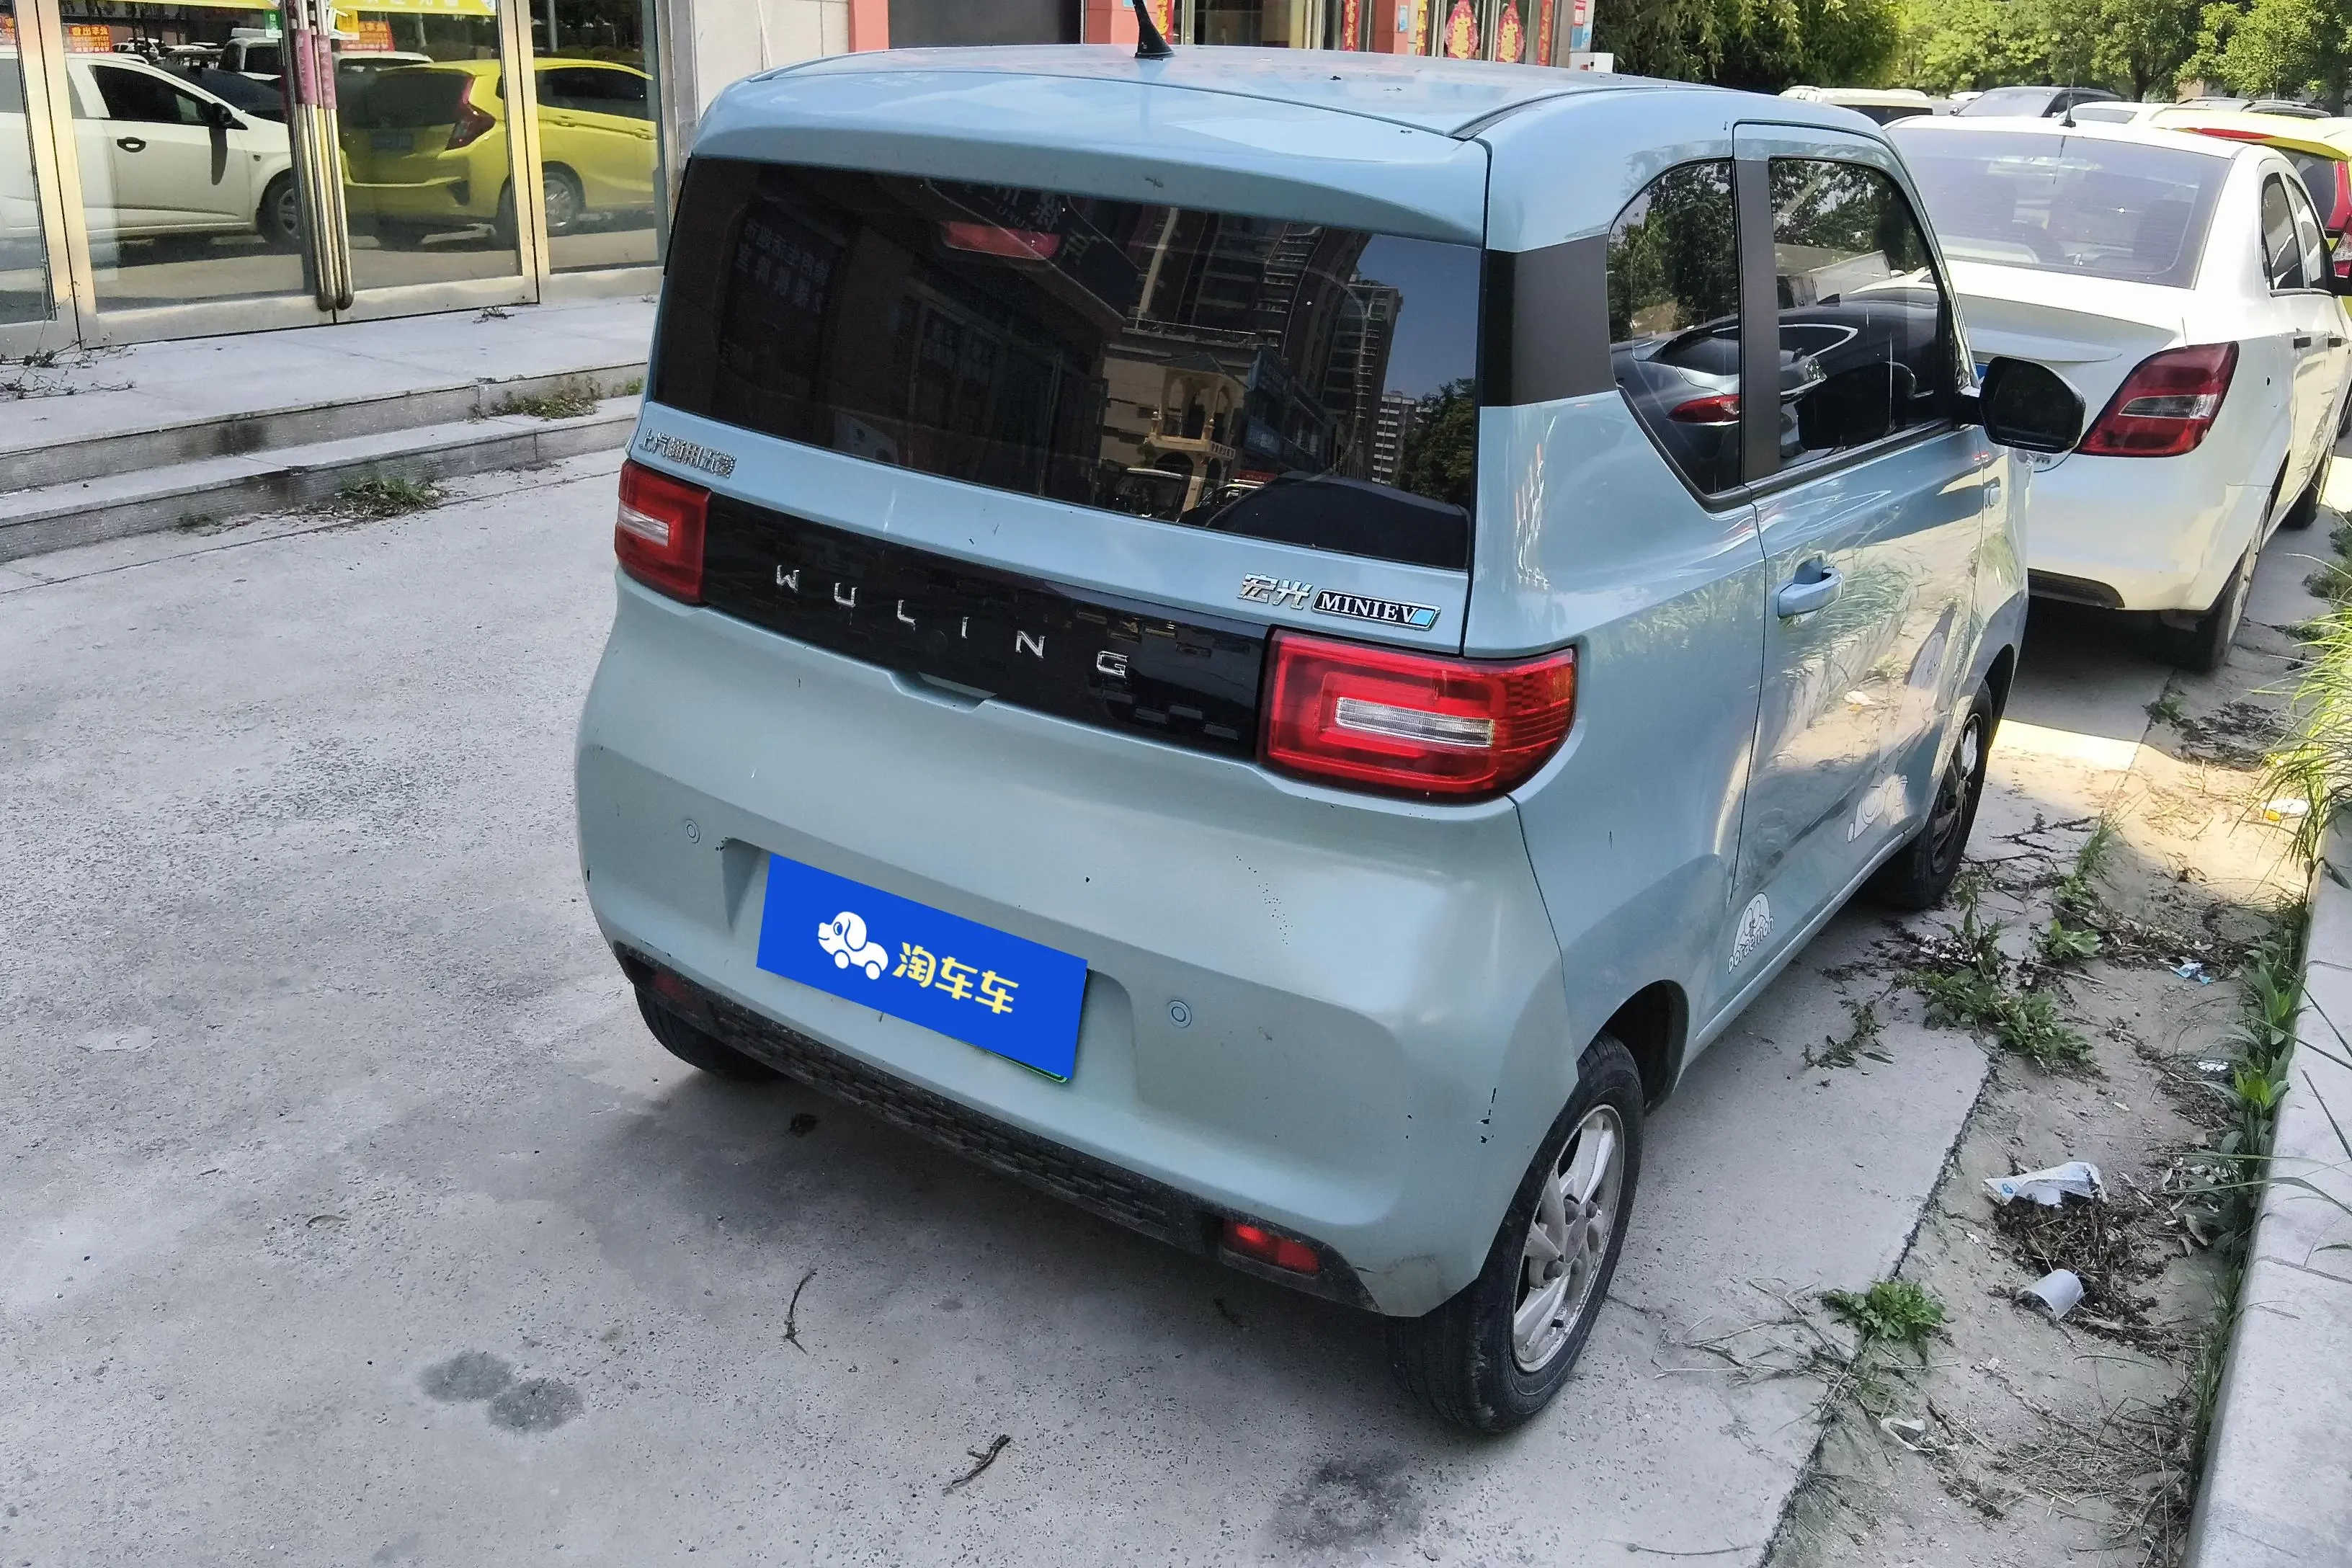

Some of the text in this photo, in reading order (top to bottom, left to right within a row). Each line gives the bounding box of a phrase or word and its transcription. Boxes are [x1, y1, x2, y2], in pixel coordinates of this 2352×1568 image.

[638, 427, 737, 478] 上汽通用五菱
[776, 564, 1129, 679] WULING
[1237, 574, 1419, 624] 宏光 MINIEV
[1727, 916, 1775, 974] Doraemon
